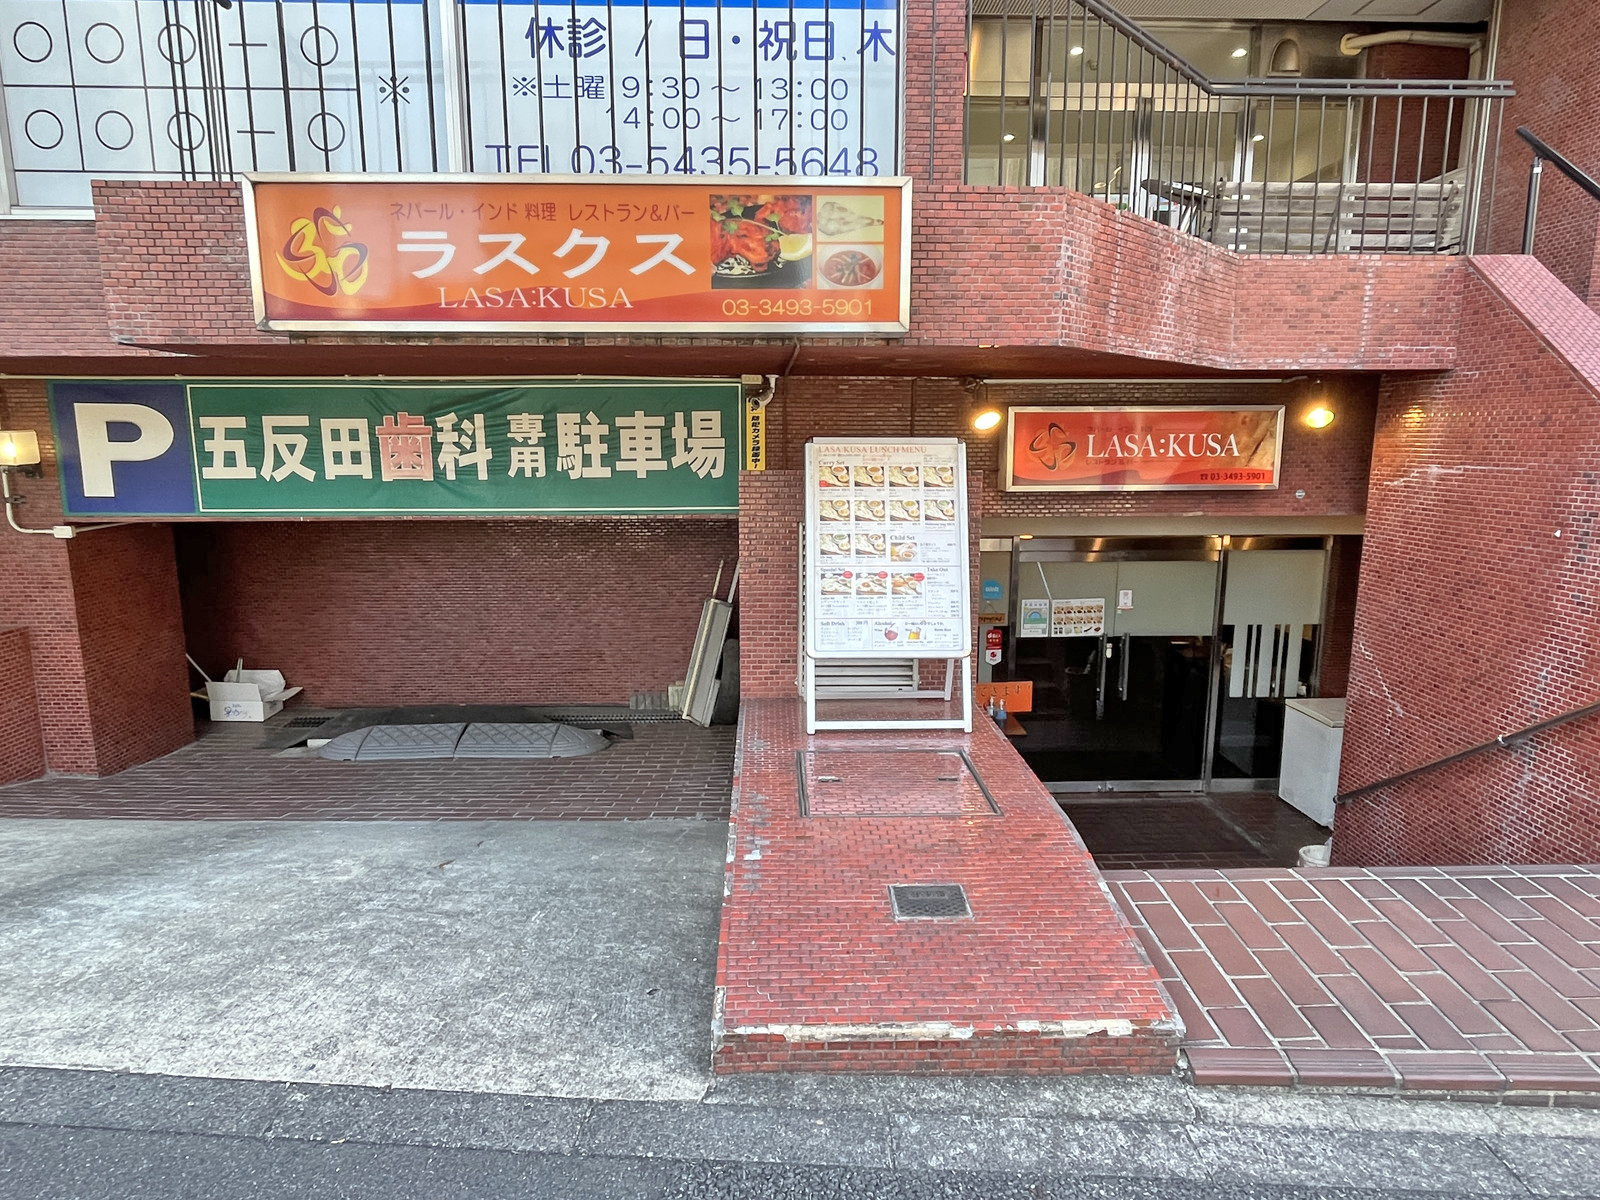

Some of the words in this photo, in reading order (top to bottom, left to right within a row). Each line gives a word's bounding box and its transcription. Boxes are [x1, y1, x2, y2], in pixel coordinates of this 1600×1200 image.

[570, 145, 879, 176] 03-5435-5648
[525, 202, 557, 222] 料理
[569, 203, 695, 222] レストラン&バー
[397, 228, 697, 279] ラスクス
[437, 286, 634, 309] LASA:KUSA
[722, 298, 873, 316] 03-3493-5901
[73, 402, 175, 498] P
[1086, 432, 1241, 458] LASA:KUSA
[1209, 471, 1266, 481] 03-3493-5901
